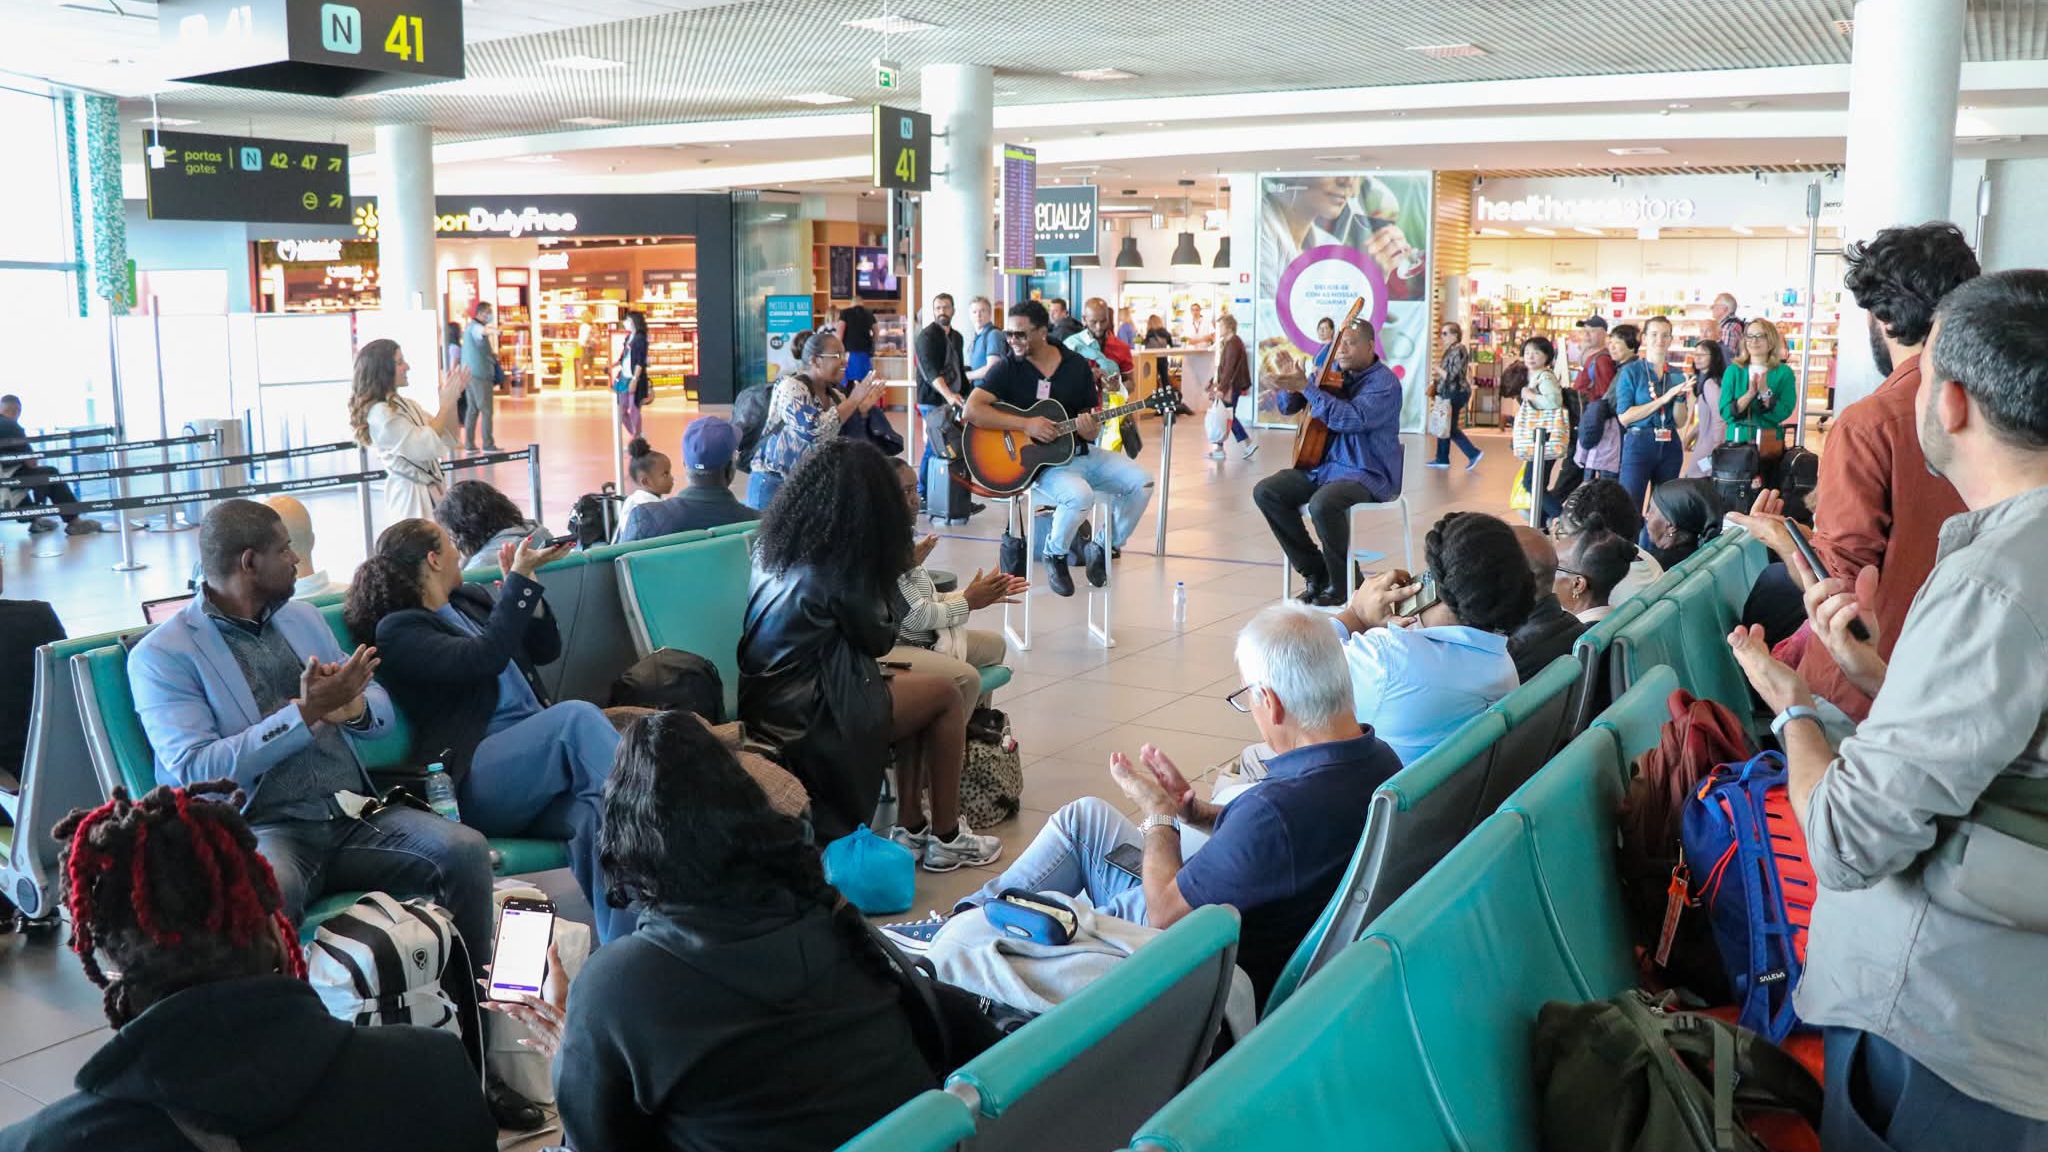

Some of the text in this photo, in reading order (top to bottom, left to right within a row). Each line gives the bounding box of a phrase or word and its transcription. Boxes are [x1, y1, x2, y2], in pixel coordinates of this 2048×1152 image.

[332, 13, 424, 63] N 41
[903, 121, 911, 135] N
[184, 150, 222, 163] portas
[246, 152, 258, 166] N
[270, 152, 289, 169] 42
[301, 155, 318, 170] 47
[185, 163, 217, 176] gates
[895, 148, 916, 183] 41
[1035, 202, 1092, 231] ECIALLY
[1477, 194, 1696, 222] healthcestore
[1759, 971, 1786, 982] SALEWA
